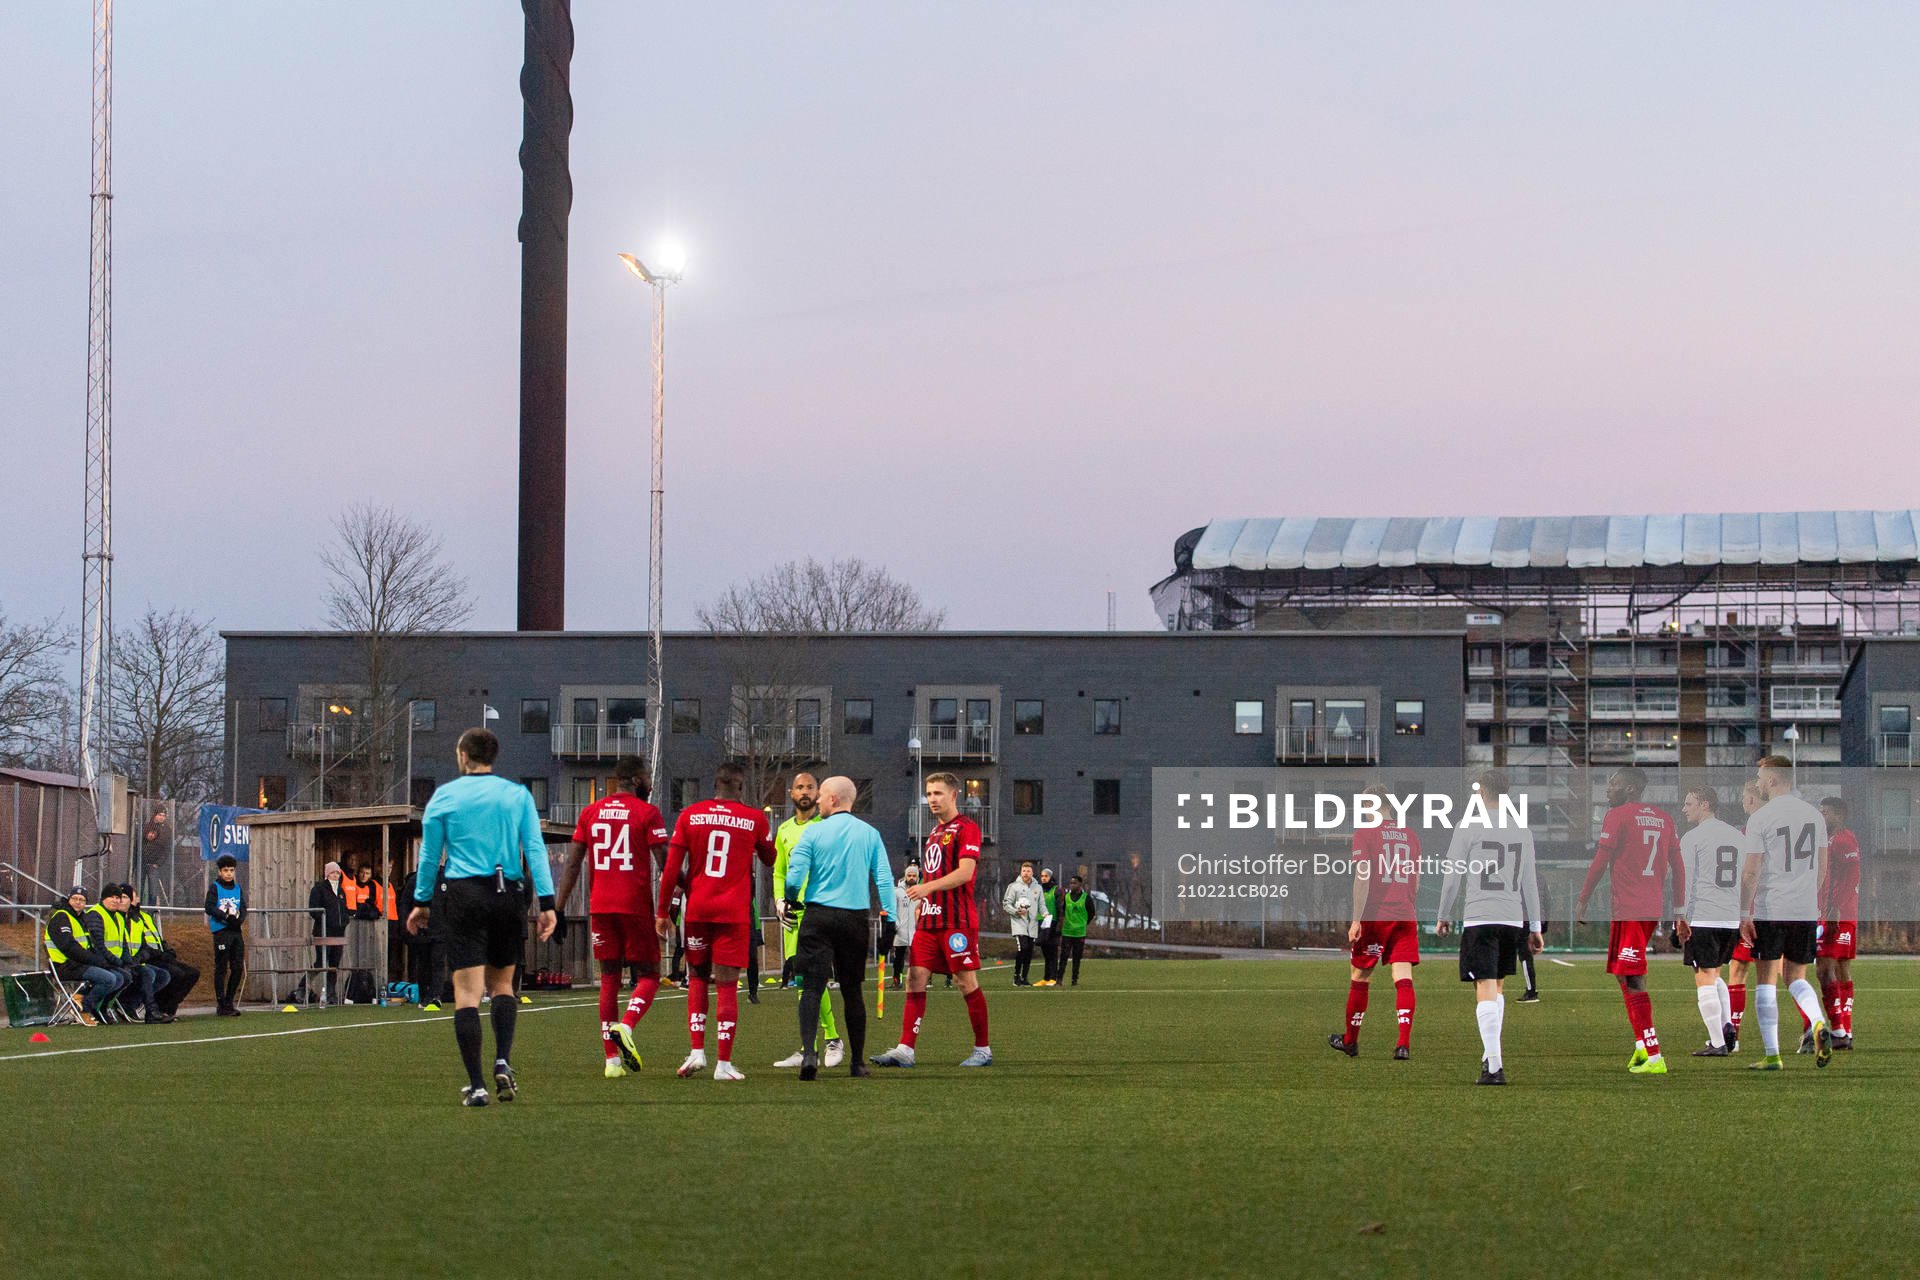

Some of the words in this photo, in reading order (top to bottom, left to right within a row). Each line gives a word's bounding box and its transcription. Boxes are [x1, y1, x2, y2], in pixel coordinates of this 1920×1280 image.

[591, 823, 634, 871] 24
[690, 814, 755, 832] SSEWANKAMBO
[705, 830, 731, 878] 8
[1480, 841, 1523, 892] 21
[1642, 830, 1661, 876] 7
[1715, 845, 1738, 888] 8
[1776, 822, 1816, 873] 14
